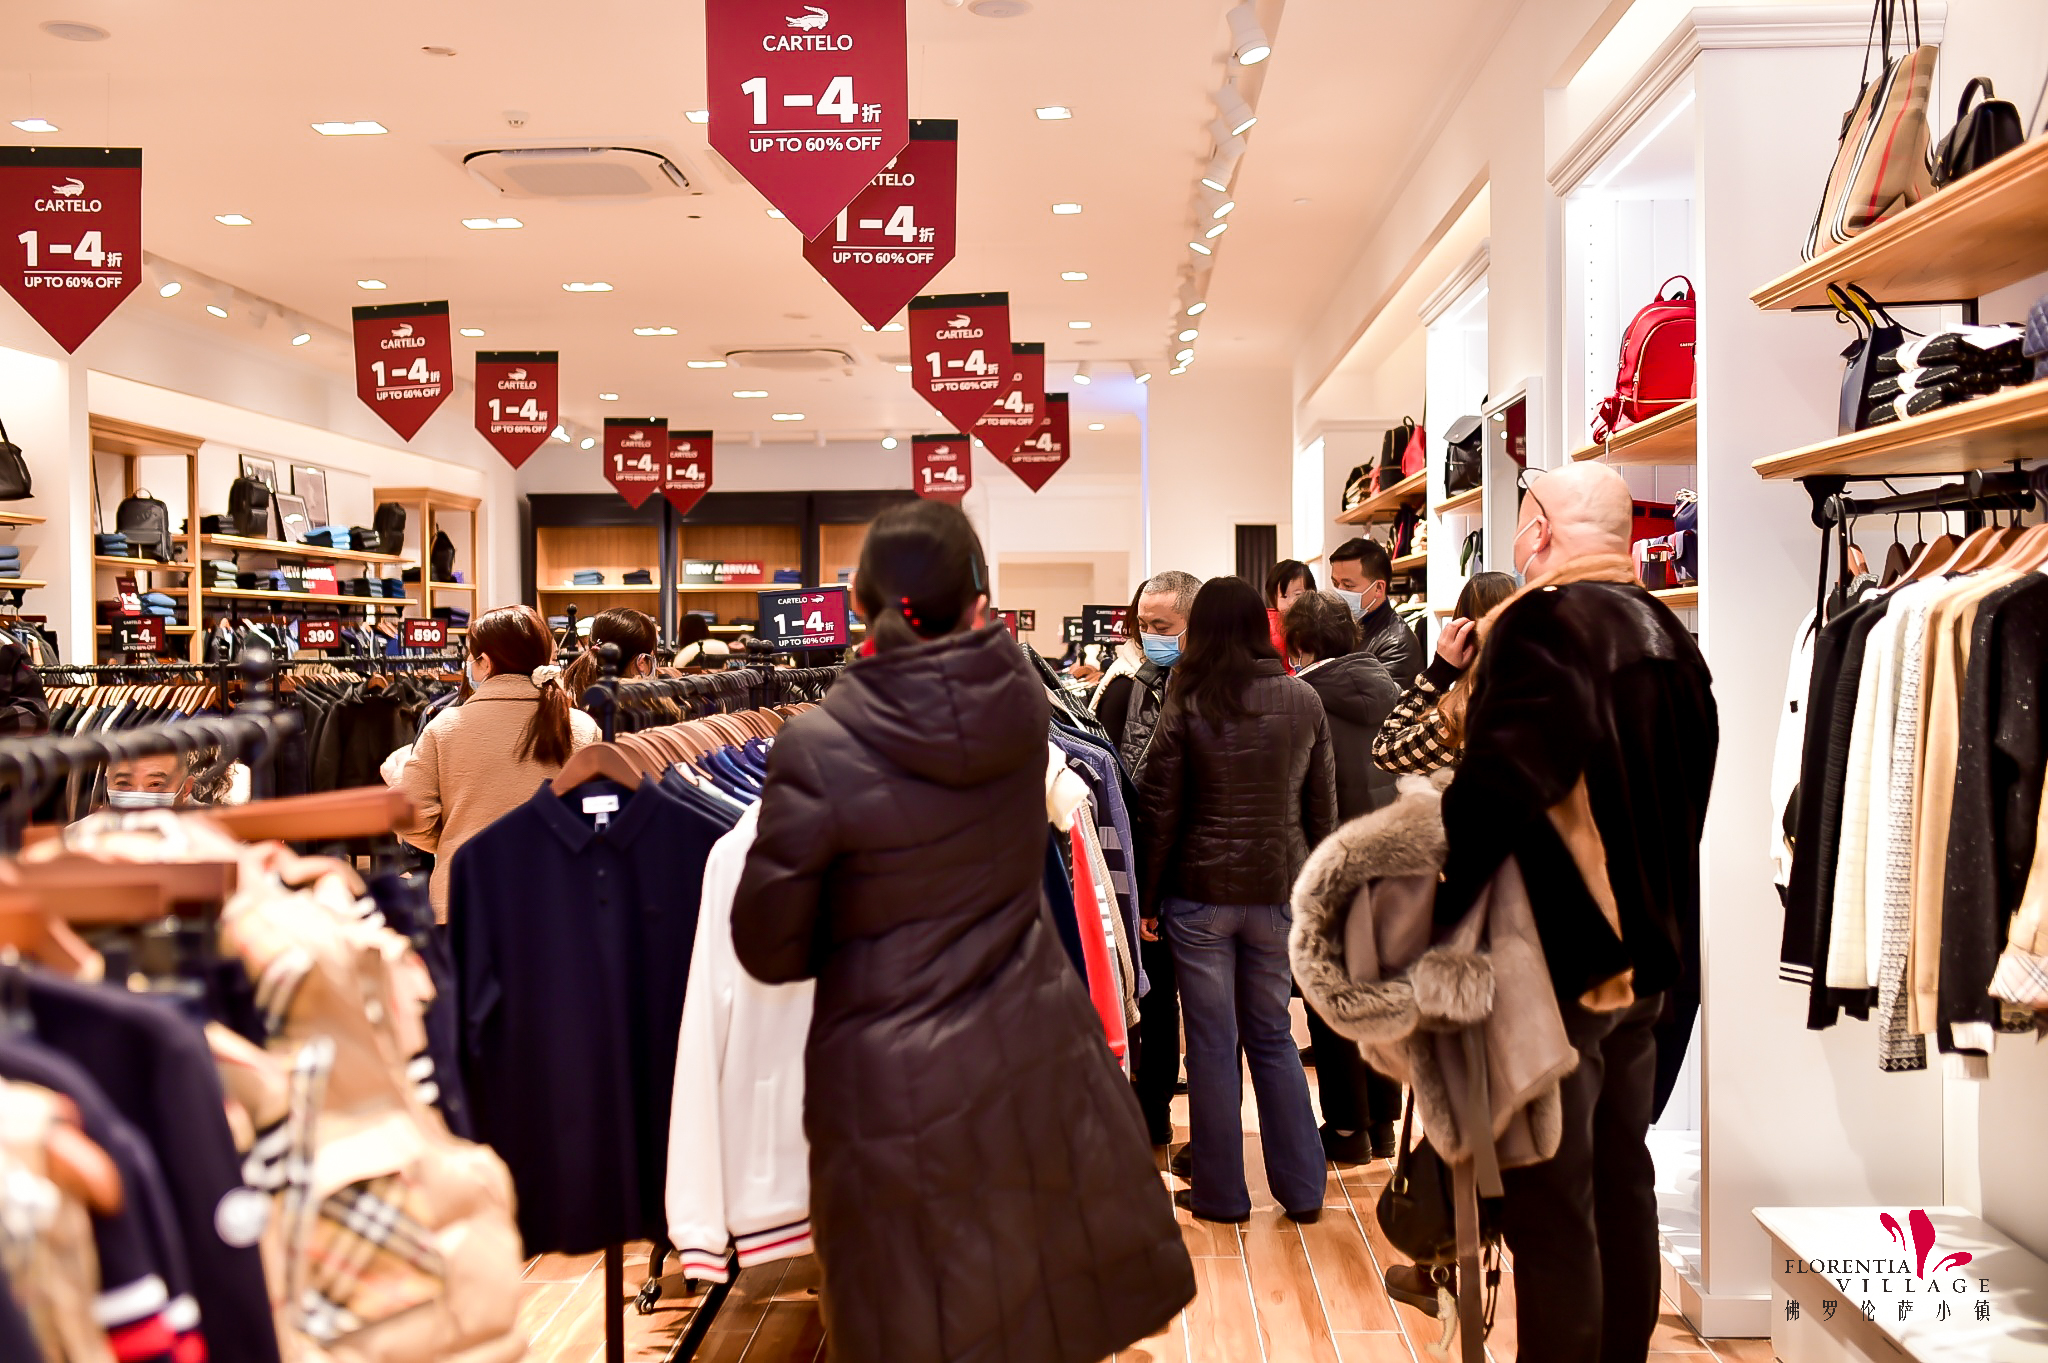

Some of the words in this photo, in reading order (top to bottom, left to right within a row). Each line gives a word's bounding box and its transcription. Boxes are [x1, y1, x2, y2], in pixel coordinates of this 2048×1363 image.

[762, 34, 854, 51] CARTELO
[750, 138, 774, 152] UP
[776, 138, 802, 152] TO
[805, 137, 844, 151] 60%
[845, 136, 882, 151] OFF
[868, 173, 915, 187] TELO
[34, 199, 102, 212] CARTELO
[832, 252, 851, 263] UP
[852, 252, 873, 263] TO
[875, 252, 904, 264] 60%
[905, 252, 935, 264] OFF
[24, 276, 42, 288] UP
[44, 276, 63, 288] TO
[65, 276, 94, 288] 60%
[95, 276, 122, 288] OFF
[935, 328, 984, 340] CARTELO
[381, 336, 425, 350] CARTELO
[497, 380, 537, 390] CARTELO
[930, 382, 945, 392] UP
[946, 382, 959, 391] TO
[980, 379, 999, 390] OFF
[376, 391, 388, 401] UP
[389, 390, 402, 400] TO
[422, 387, 440, 398] OFF
[778, 597, 807, 605] CARTELO
[802, 637, 819, 645] 60%
[819, 636, 834, 644] OFF
